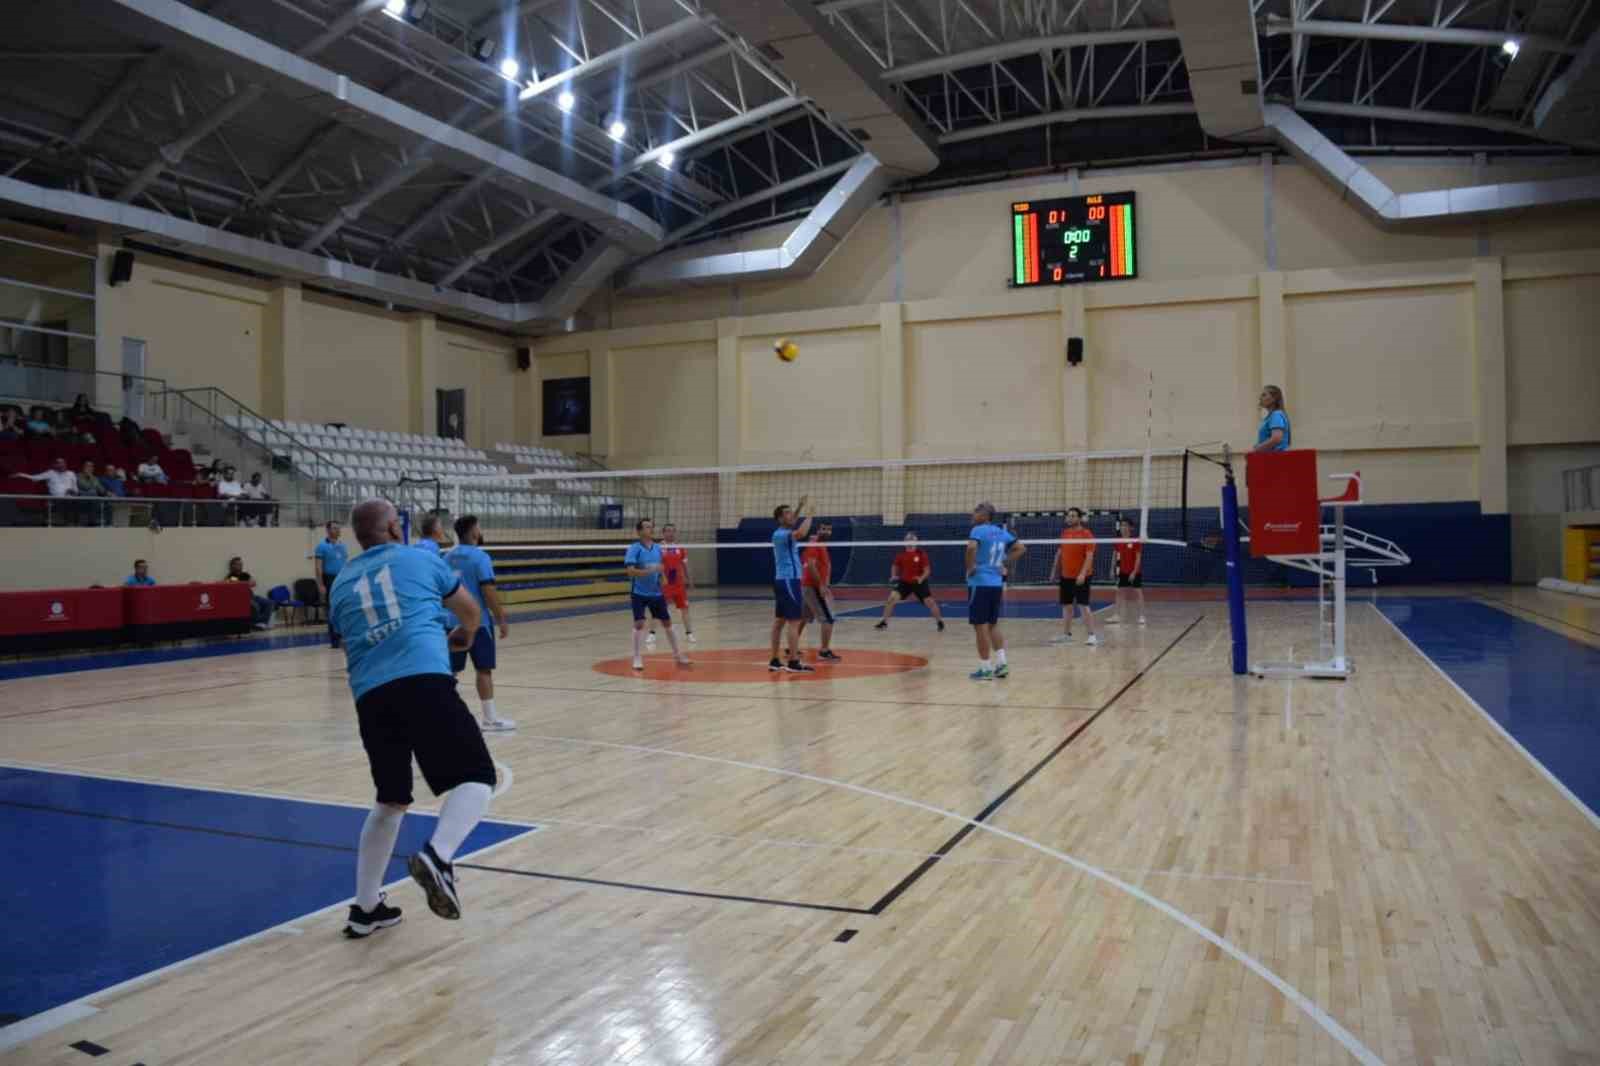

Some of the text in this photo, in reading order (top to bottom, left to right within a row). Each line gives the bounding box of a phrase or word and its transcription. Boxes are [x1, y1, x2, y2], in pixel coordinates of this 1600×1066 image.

[1088, 206, 1105, 220] 00
[1064, 229, 1091, 244] 0:00
[1069, 245, 1078, 259] 2
[1053, 268, 1062, 281] 0
[353, 564, 400, 626] 11
